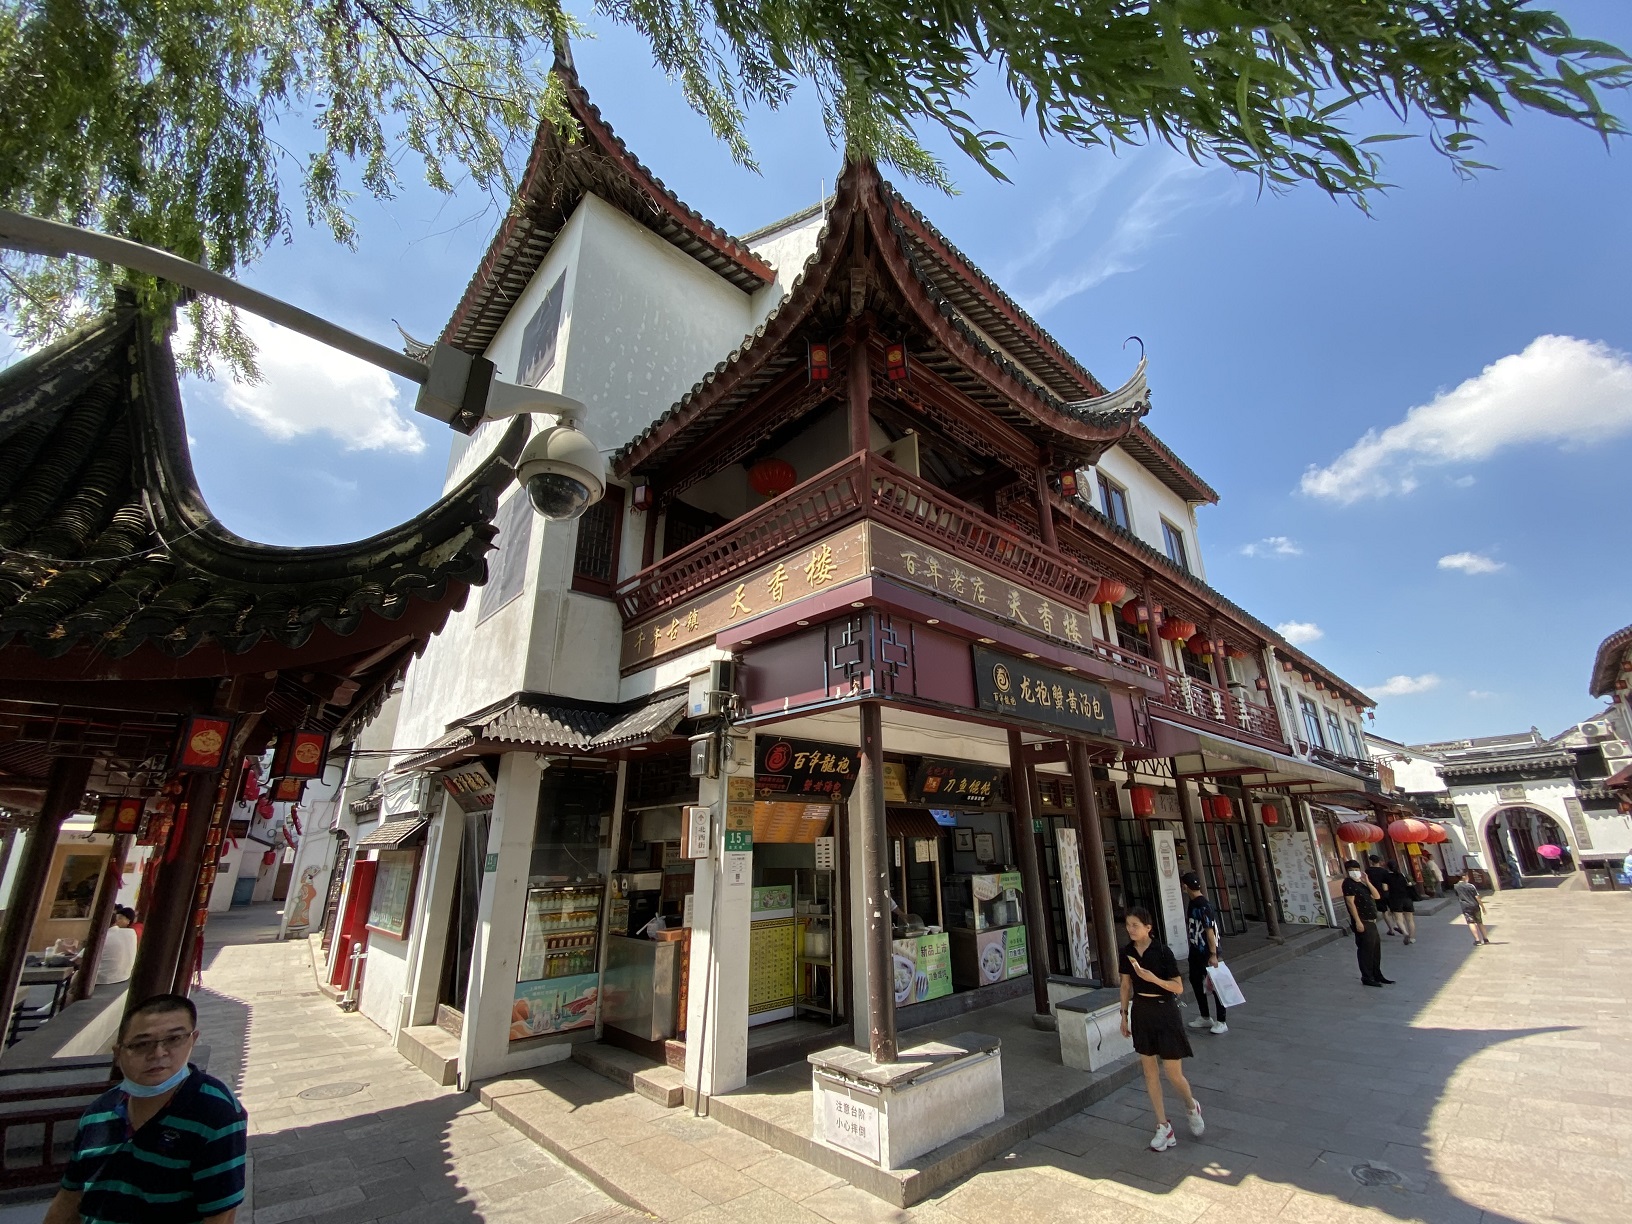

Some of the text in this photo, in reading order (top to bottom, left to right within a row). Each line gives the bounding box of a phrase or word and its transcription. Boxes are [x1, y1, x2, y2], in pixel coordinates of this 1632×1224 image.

[729, 543, 838, 619] 天香楼
[901, 551, 1083, 645] 百年老店 天香楼
[1019, 675, 1105, 721] 龙袍蟹黄汤包
[943, 777, 992, 796] 刀鱼馄饨
[730, 832, 742, 844] 15
[920, 943, 948, 958] 新品上市
[835, 1100, 866, 1121] 注意台阶
[835, 1117, 866, 1138] 小心摔倒
